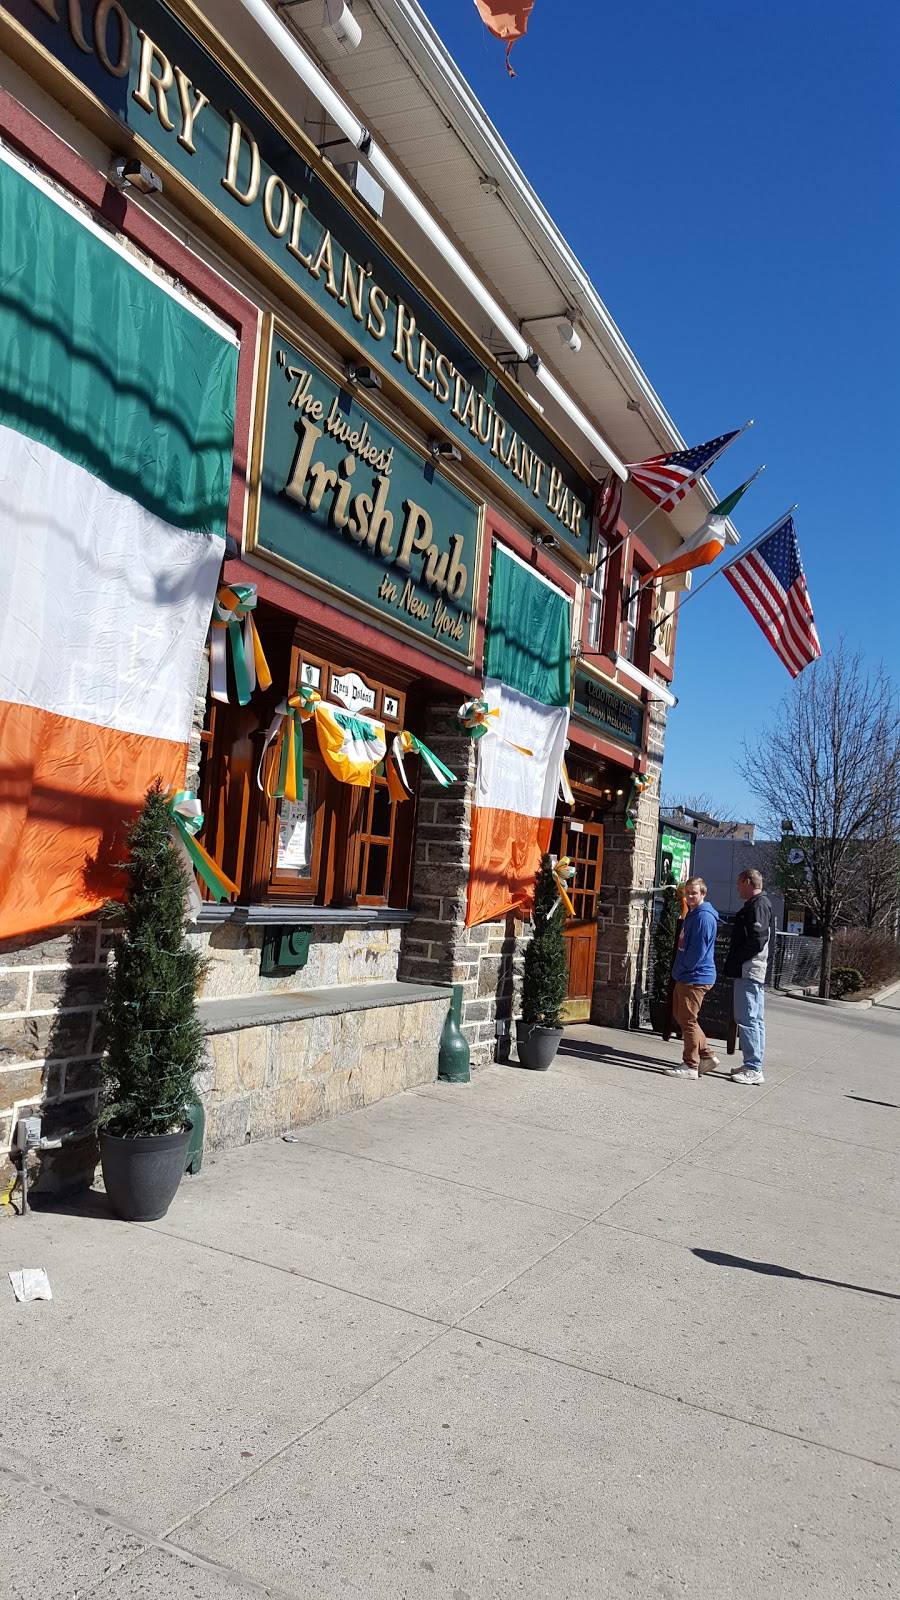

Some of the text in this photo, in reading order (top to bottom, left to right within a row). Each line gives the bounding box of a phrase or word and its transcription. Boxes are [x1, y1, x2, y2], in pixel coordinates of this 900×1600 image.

[221, 109, 388, 341] DOLAN'S
[392, 295, 545, 497] RESTAURANT
[546, 463, 585, 538] BAR
[326, 396, 395, 475] liveliest
[284, 416, 468, 601] Irish Pub
[379, 573, 398, 601] in
[400, 577, 430, 618] New
